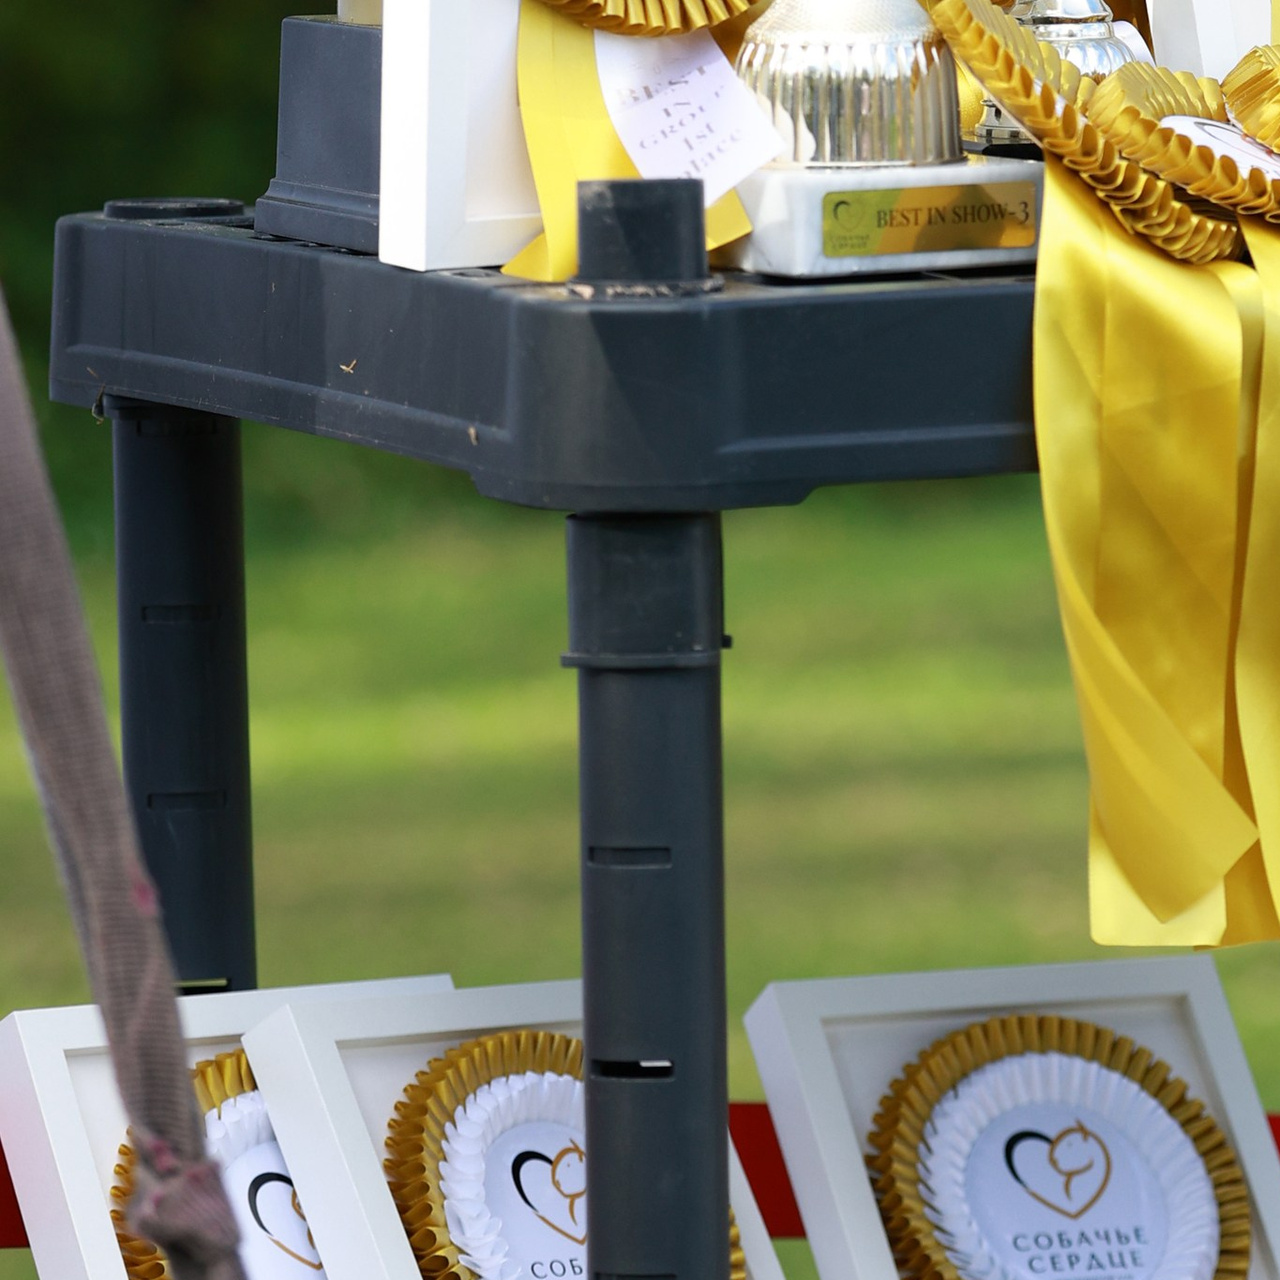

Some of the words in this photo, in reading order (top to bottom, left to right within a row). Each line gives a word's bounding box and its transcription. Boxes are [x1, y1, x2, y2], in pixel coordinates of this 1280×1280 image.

[876, 207, 925, 229] BEST
[926, 206, 949, 226] IN
[1012, 1225, 1149, 1252] СОБАЧЬЕ
[1027, 1250, 1144, 1274] СЕРДЦЕ
